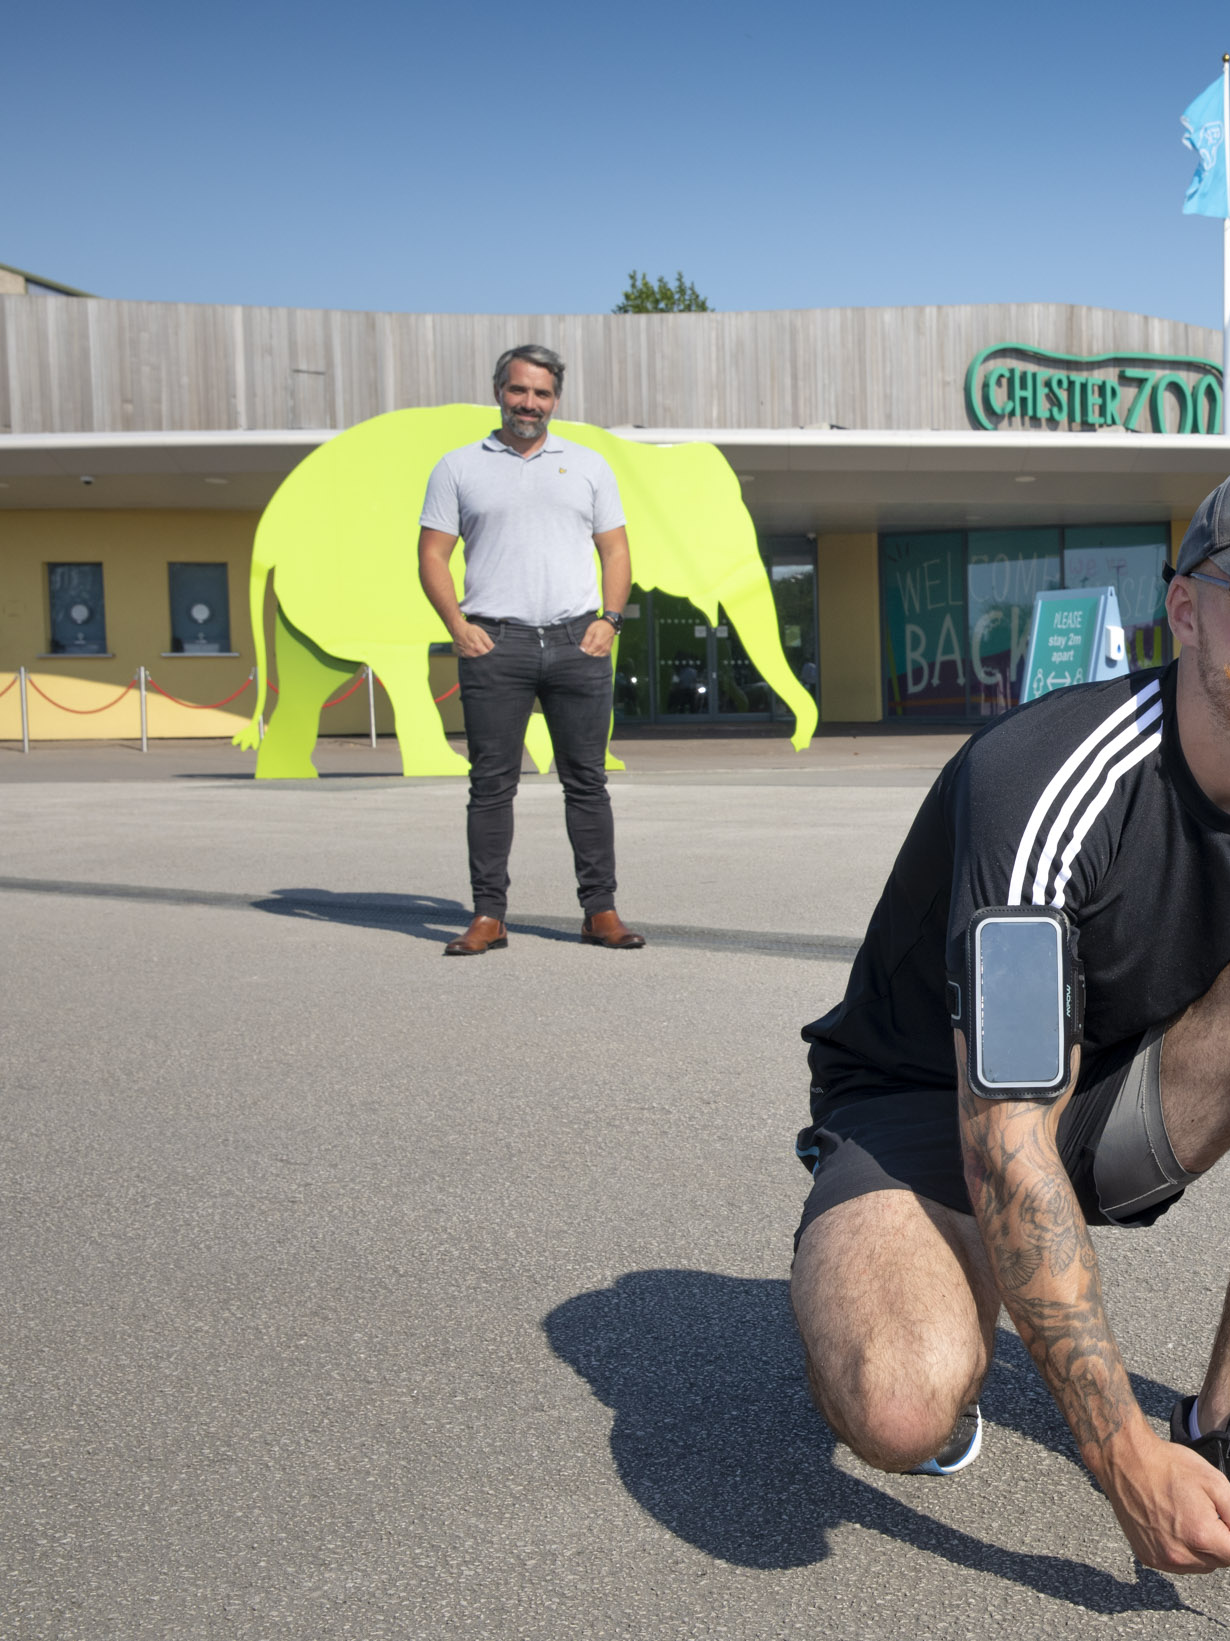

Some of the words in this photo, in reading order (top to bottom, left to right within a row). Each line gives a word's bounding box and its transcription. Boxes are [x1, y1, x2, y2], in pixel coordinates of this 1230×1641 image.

[984, 366, 1121, 427] CHESTER
[1119, 369, 1222, 434] ZOO
[1053, 611, 1083, 629] PLEASE
[904, 606, 1029, 694] BACK
[1048, 635, 1067, 649] stay
[1067, 633, 1082, 646] 2m
[1051, 650, 1075, 664] apart
